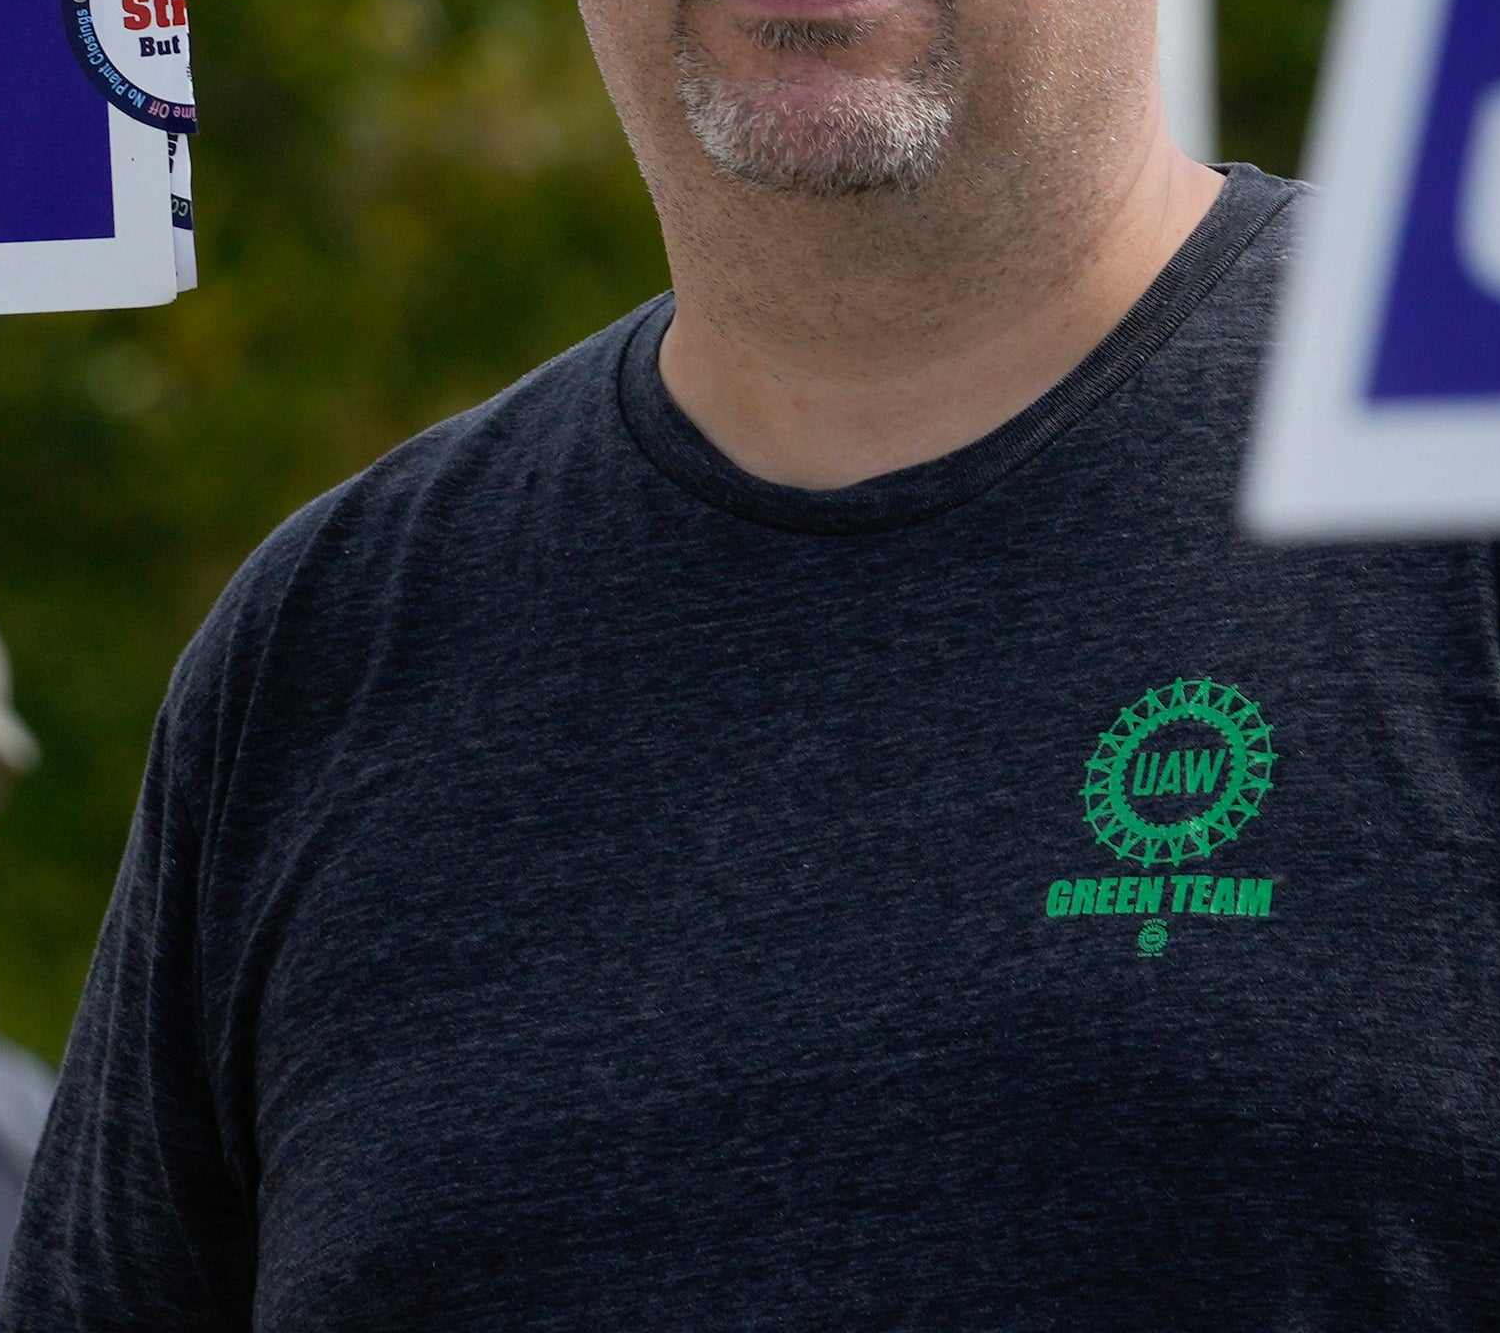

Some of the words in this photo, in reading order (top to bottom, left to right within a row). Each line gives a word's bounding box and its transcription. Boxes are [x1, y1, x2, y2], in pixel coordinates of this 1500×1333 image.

[76, 8, 104, 65] Closings
[139, 35, 181, 57] But
[97, 62, 130, 96] Plant
[127, 88, 147, 109] No
[1132, 749, 1226, 796] UAW
[1046, 876, 1165, 917] GREEN
[1171, 875, 1274, 916] TEAM
